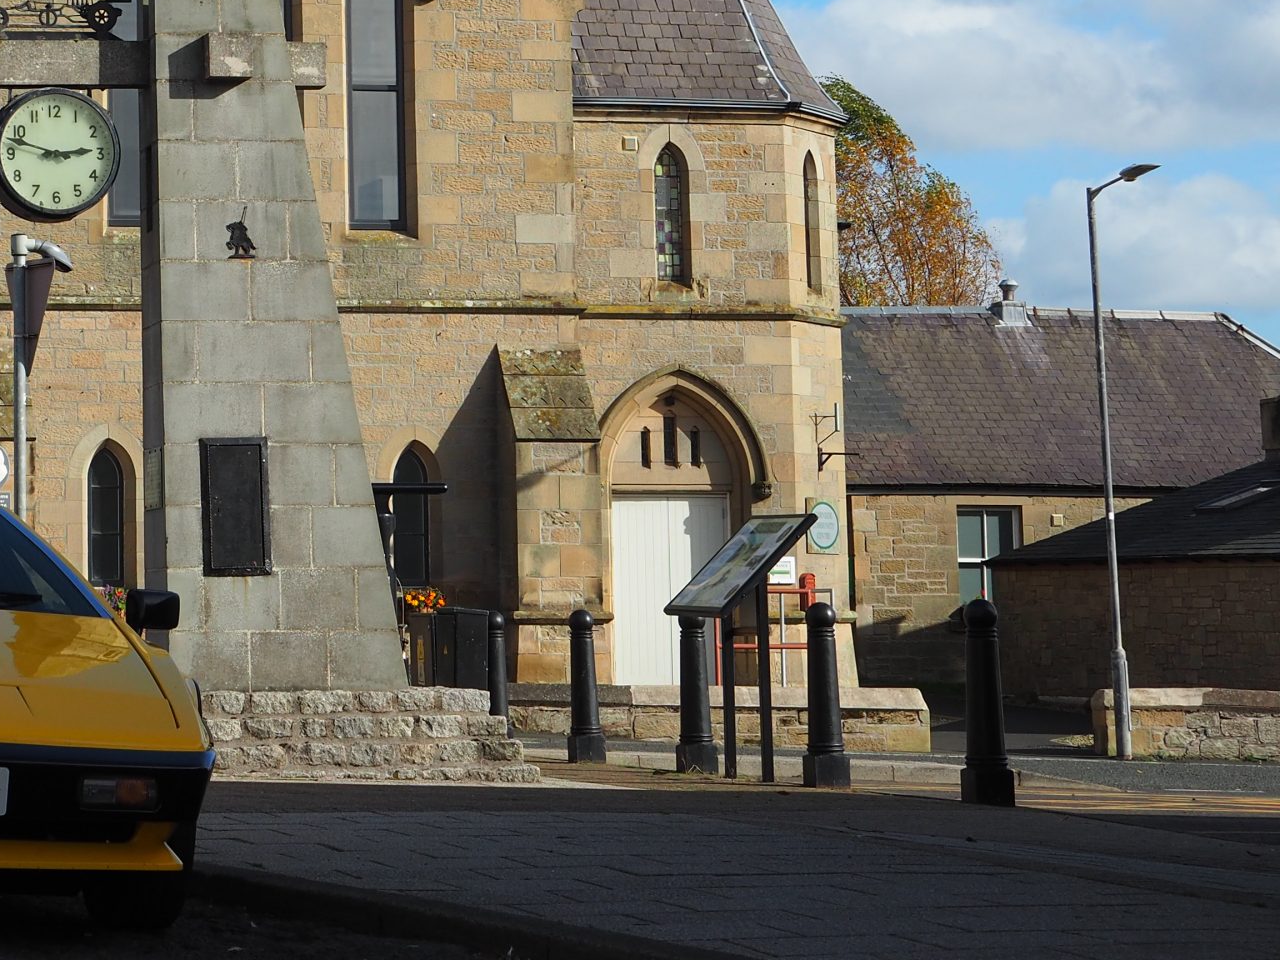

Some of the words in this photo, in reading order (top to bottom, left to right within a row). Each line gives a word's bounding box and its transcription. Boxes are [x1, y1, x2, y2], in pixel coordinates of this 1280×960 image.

[30, 110, 39, 123] 11
[48, 104, 61, 118] 12
[74, 110, 78, 123] 1
[13, 125, 26, 138] 10
[88, 125, 98, 138] 2
[6, 147, 16, 161] 9
[96, 147, 105, 160] 3
[13, 169, 22, 182] 8
[88, 169, 99, 182] 4
[31, 184, 41, 197] 7
[73, 184, 82, 197] 5
[52, 191, 61, 204] 6
